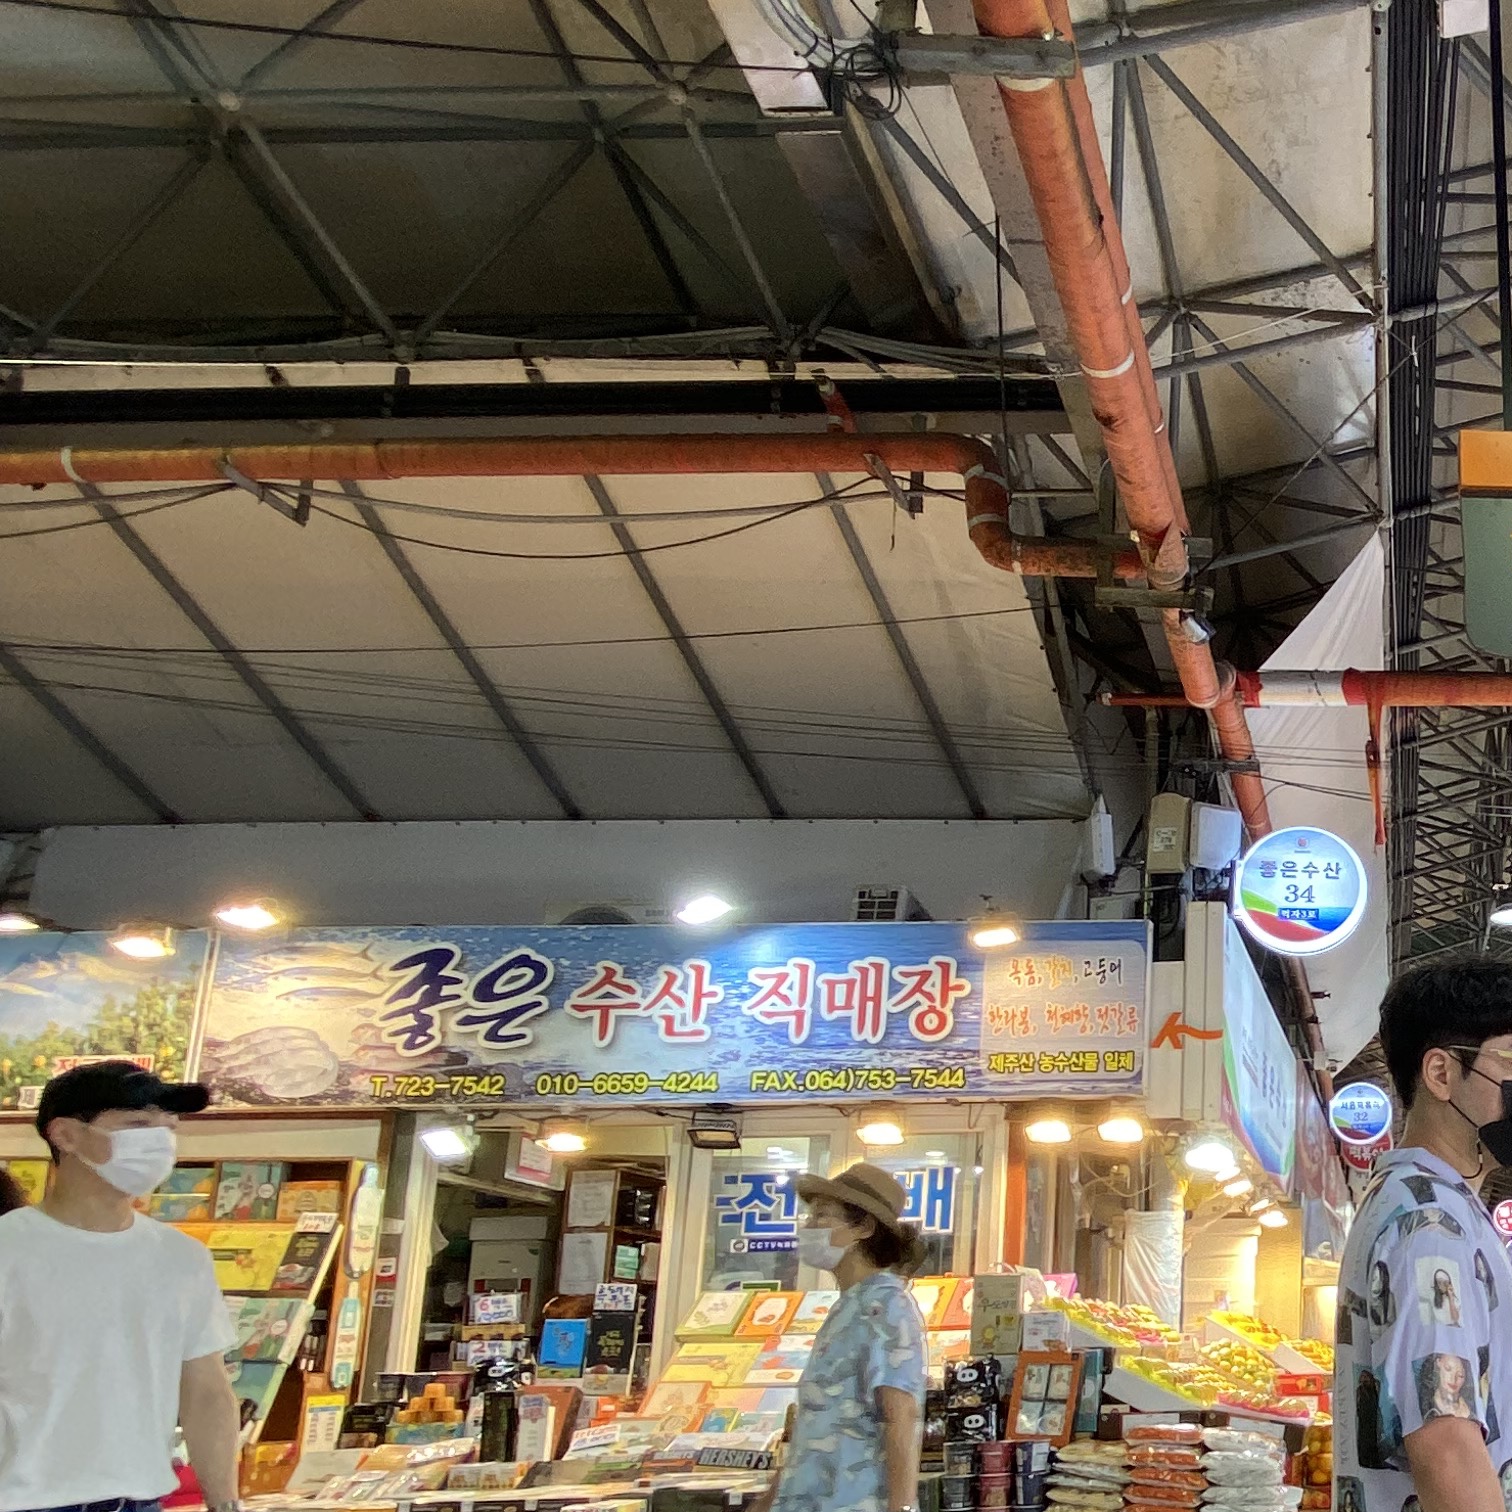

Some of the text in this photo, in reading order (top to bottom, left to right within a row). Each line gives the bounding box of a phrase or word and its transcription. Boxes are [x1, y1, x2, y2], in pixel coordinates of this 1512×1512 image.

[1259, 861, 1342, 880] 좋은수산
[1284, 884, 1315, 904] 34
[1280, 908, 1318, 920] 먹자3로
[378, 946, 967, 1052] 좋은 수산 직매장
[988, 1004, 1036, 1036] 한라봉,
[989, 1051, 1135, 1072] 제주산 농수산물 일체
[371, 1068, 966, 1097] T.723-7542 010-6659-4244 FAX.064)753-7544
[1354, 1112, 1369, 1121] 32
[699, 1447, 773, 1470] HERSHEY'S
